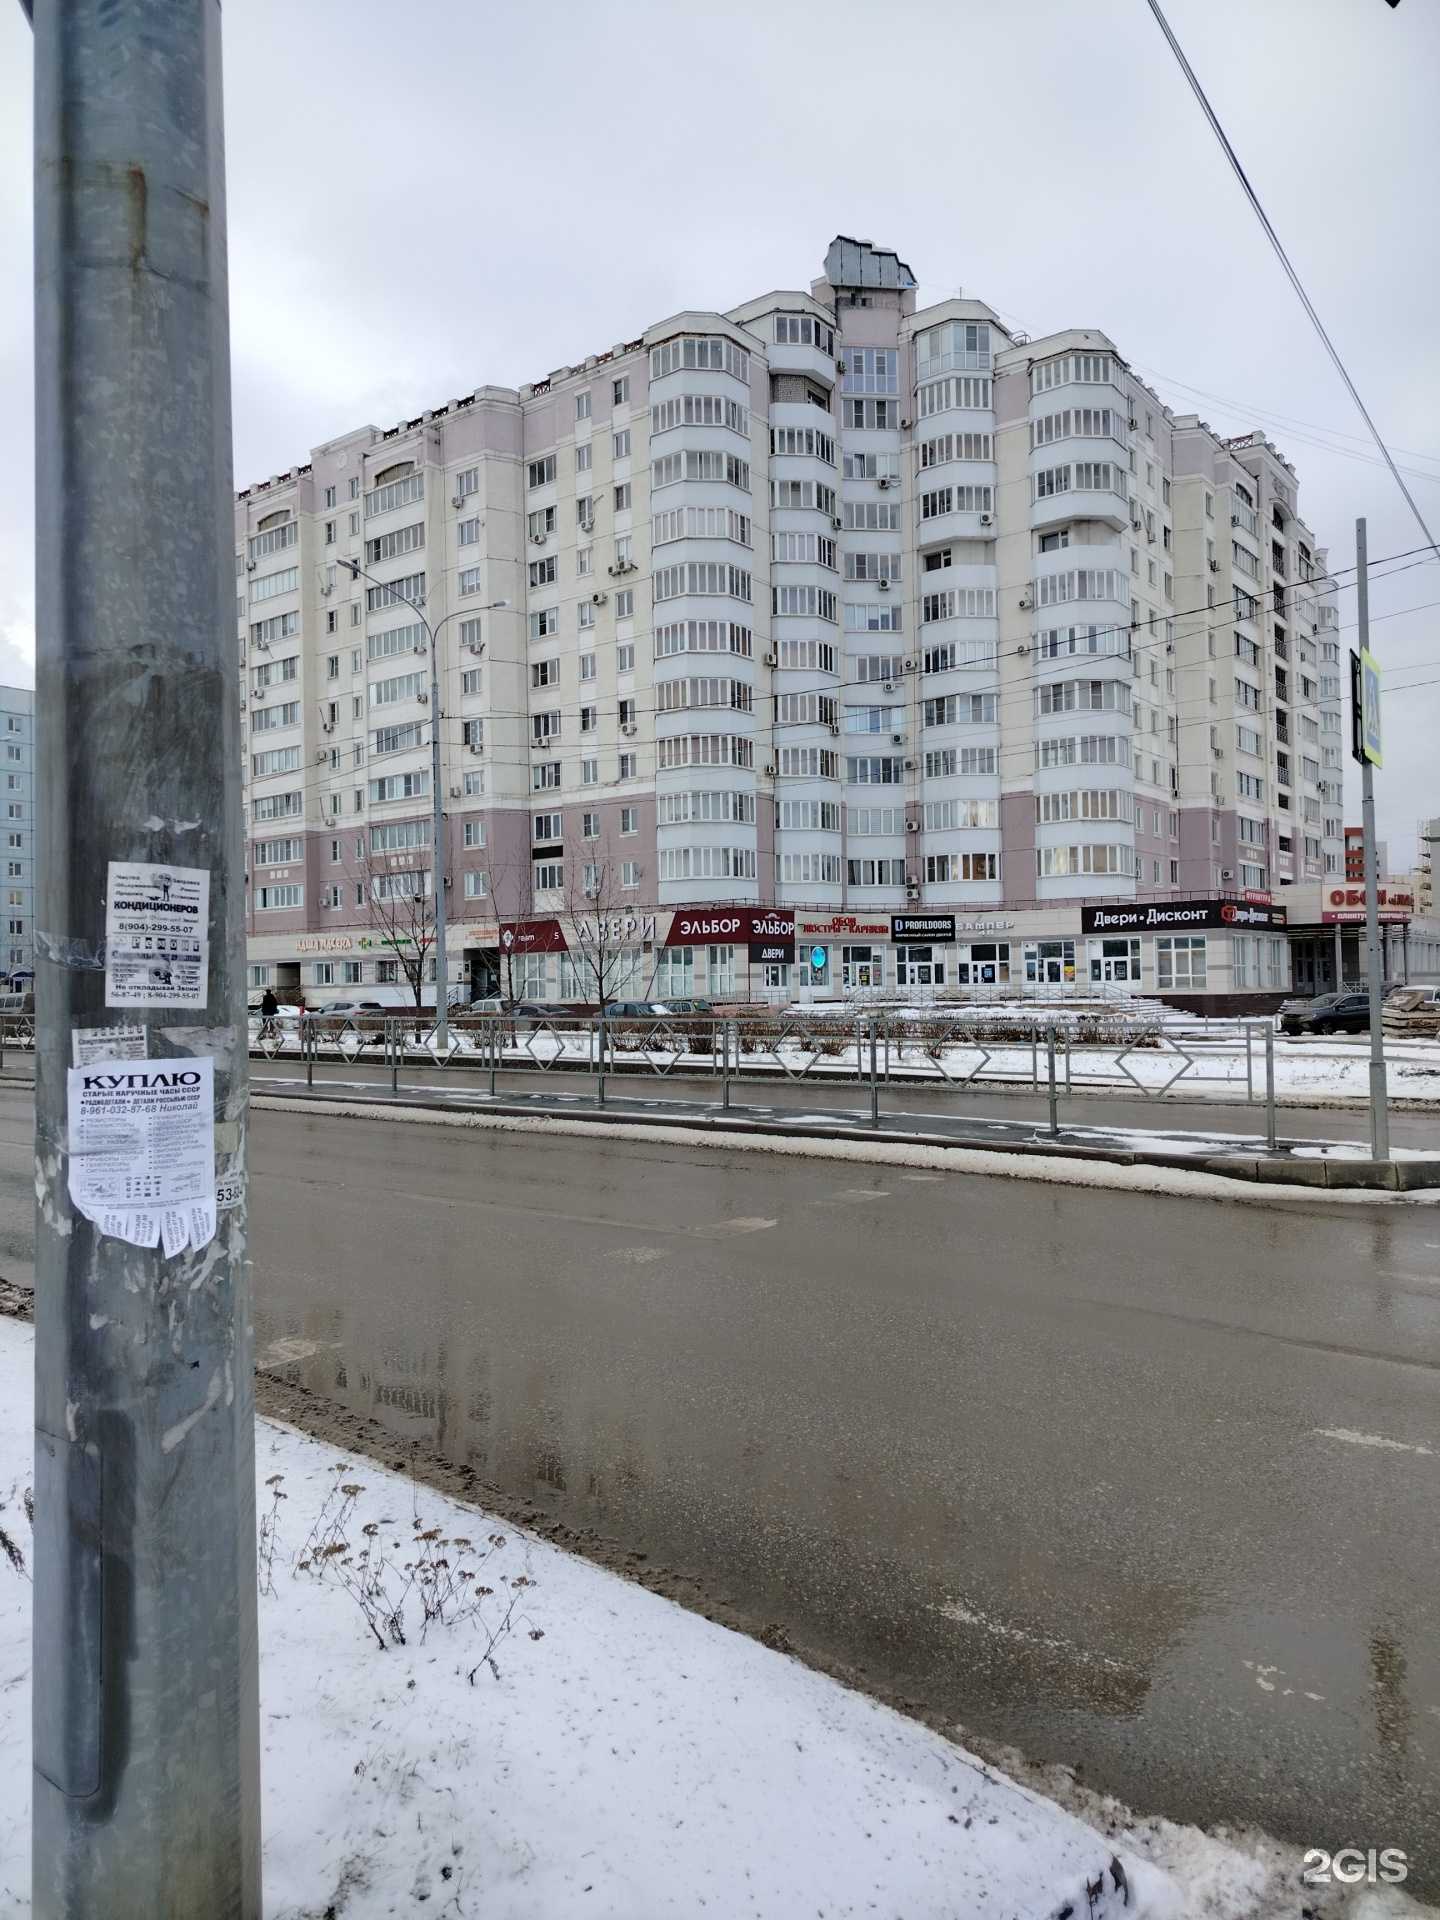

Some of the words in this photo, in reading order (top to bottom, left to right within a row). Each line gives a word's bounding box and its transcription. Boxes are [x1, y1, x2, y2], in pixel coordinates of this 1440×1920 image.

[114, 900, 198, 914] КОНДИЦИОНЕРОВ
[1093, 910, 1137, 927] Двери
[1146, 908, 1208, 924] Дисконт
[680, 918, 740, 935] ЭЛЬБОР
[752, 919, 794, 936] ЭЛЬБОР
[761, 948, 784, 959] ДВЕРИ
[83, 1071, 201, 1090] КУПЛЮ
